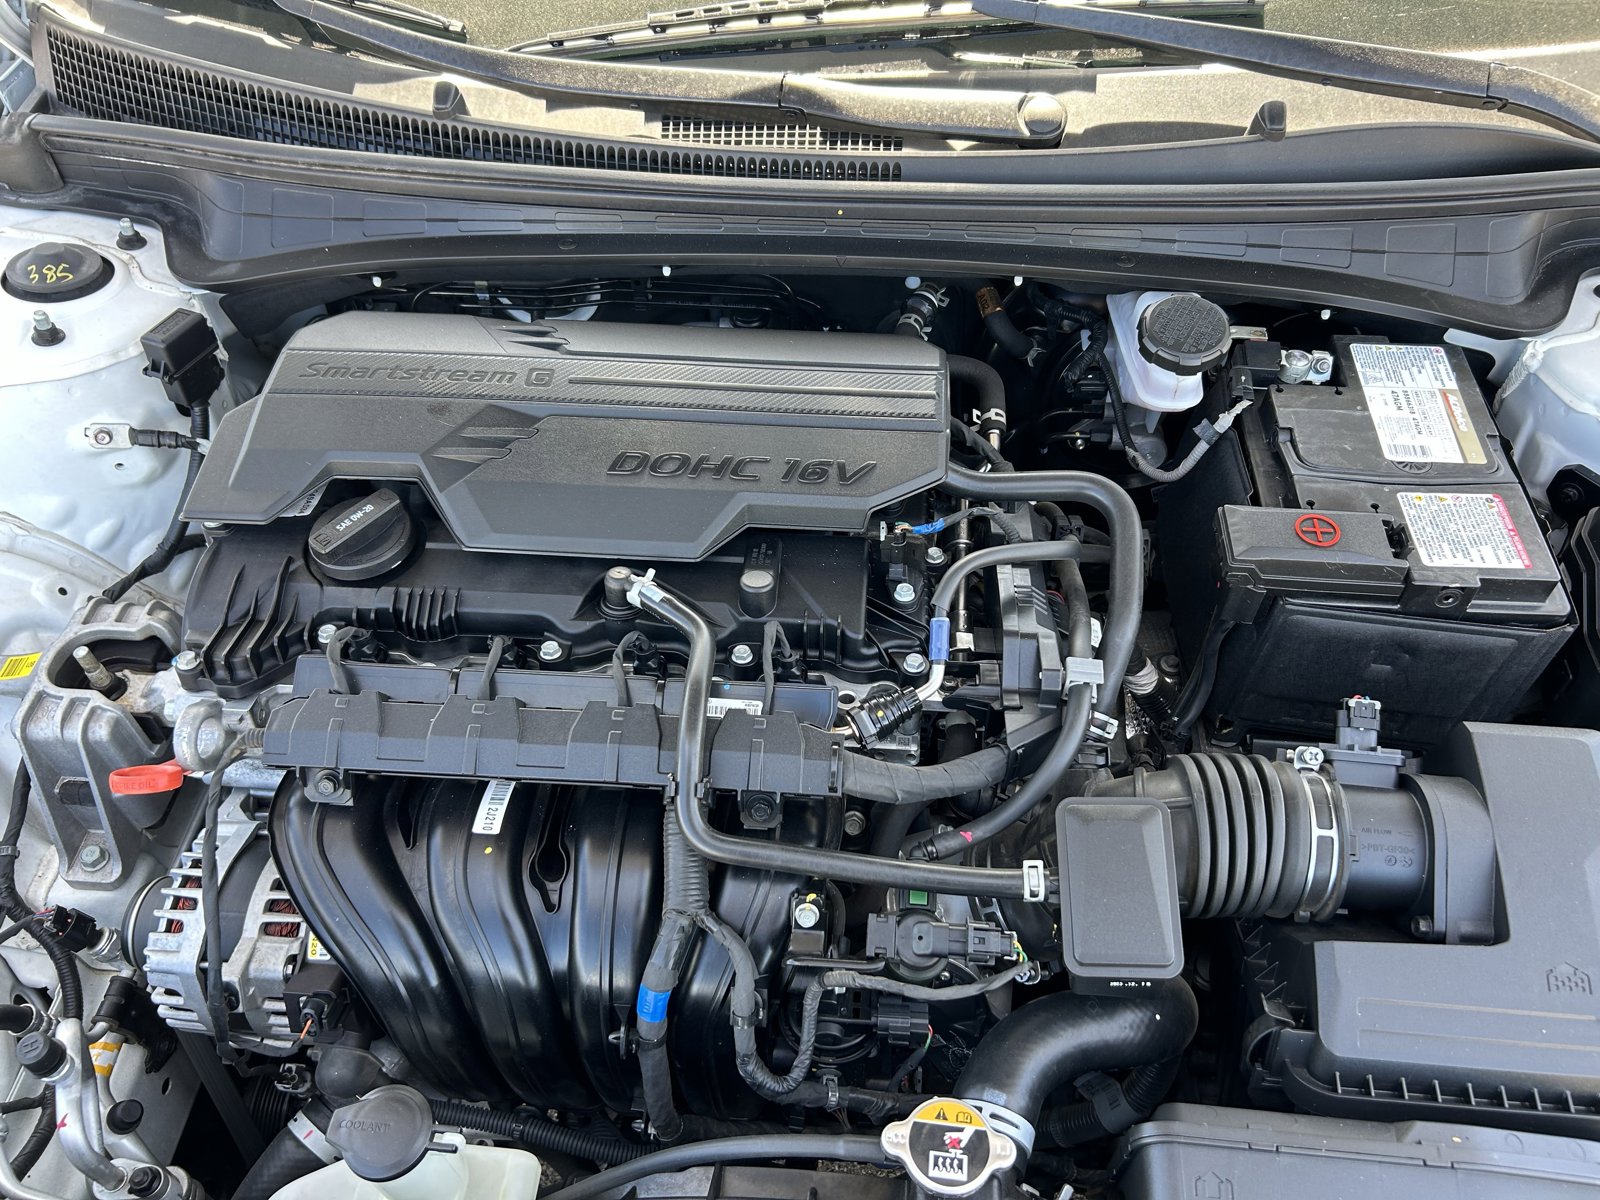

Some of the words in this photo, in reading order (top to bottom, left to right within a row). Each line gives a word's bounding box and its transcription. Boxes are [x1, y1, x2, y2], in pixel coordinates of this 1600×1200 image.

[27, 263, 74, 284] 385
[300, 362, 518, 385] Smartstream
[1390, 390, 1404, 410] 47AGM
[1446, 393, 1469, 432] ACDelco
[606, 450, 771, 480] DOHC
[780, 457, 877, 485] 16V
[335, 518, 353, 531] SAE
[350, 504, 375, 521] 0W-20
[482, 807, 499, 831] 2J210
[339, 1119, 391, 1133] COOLANT
